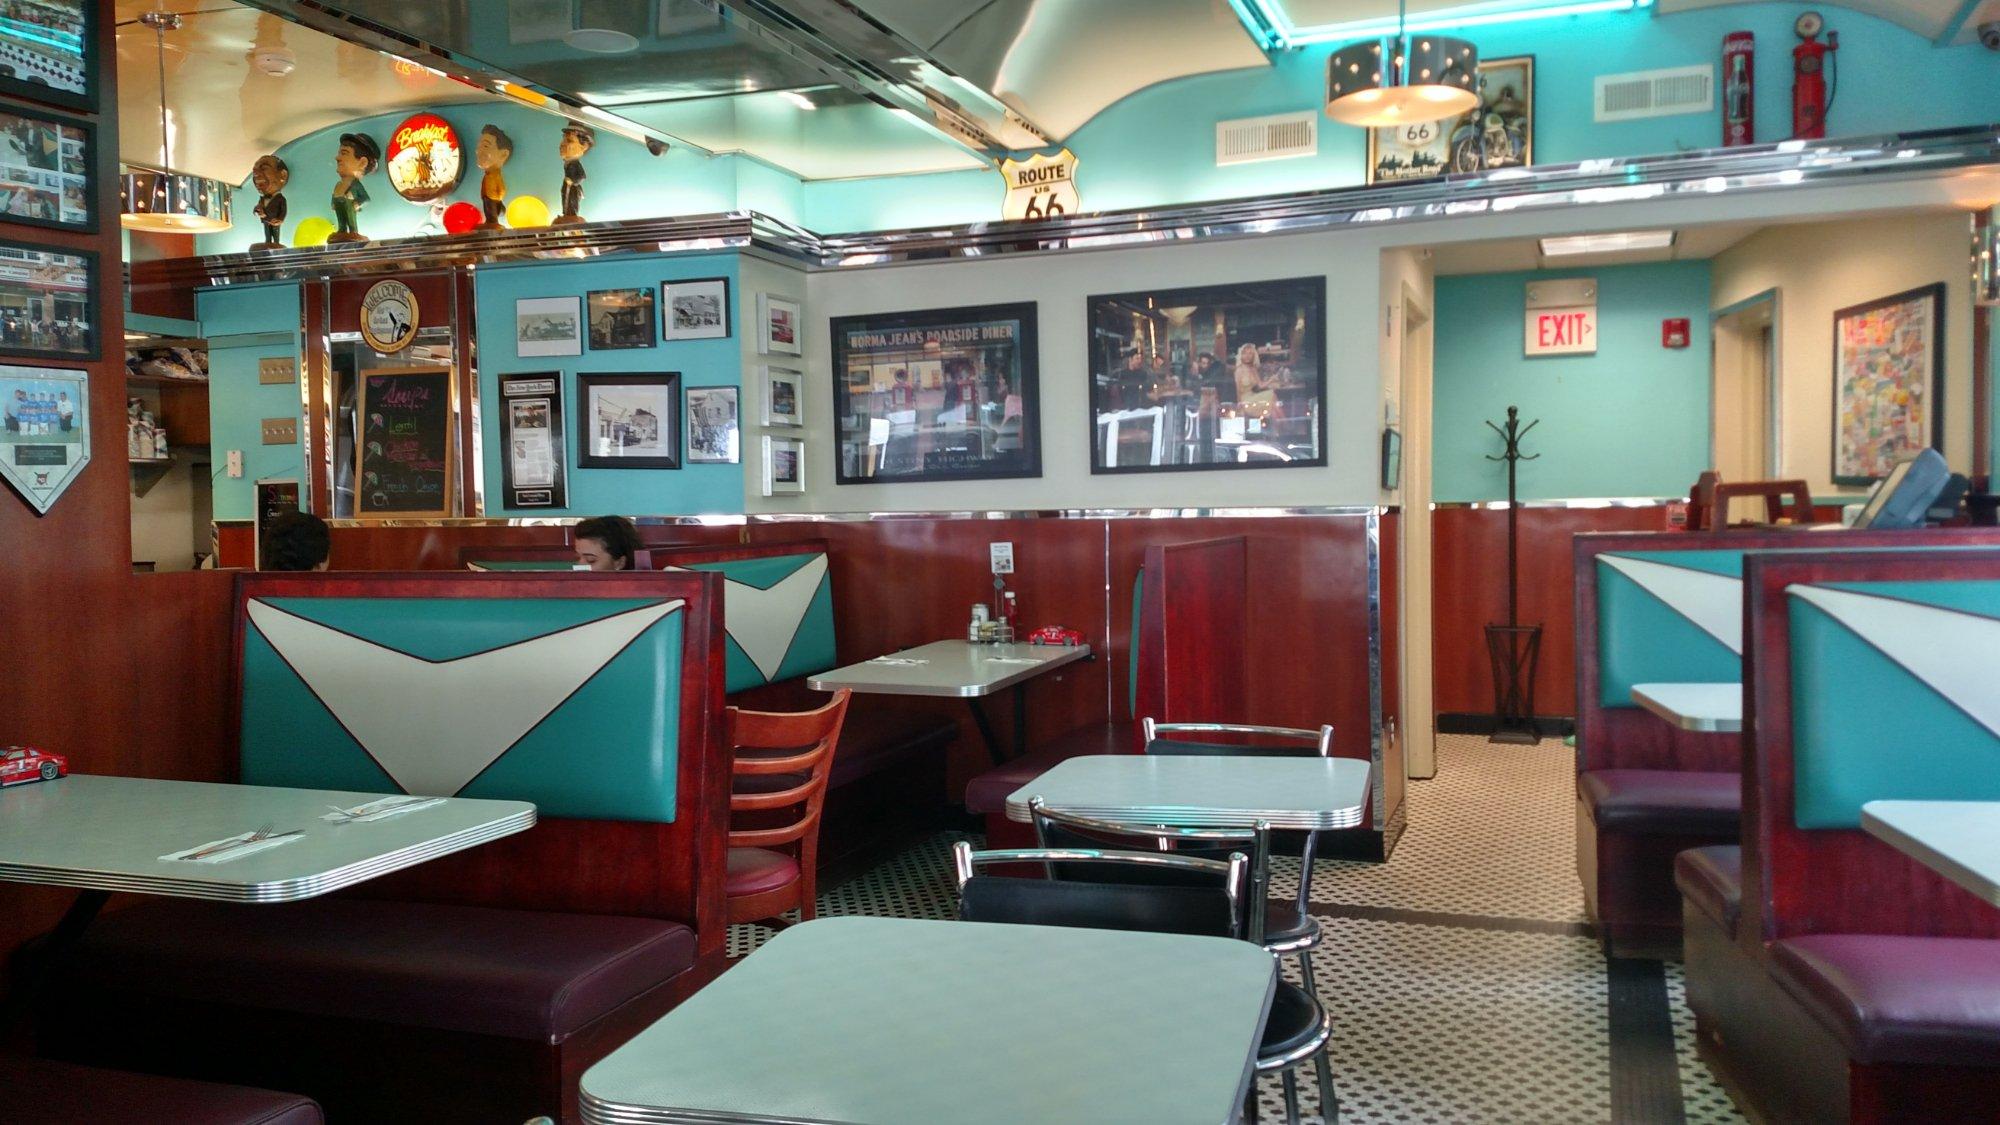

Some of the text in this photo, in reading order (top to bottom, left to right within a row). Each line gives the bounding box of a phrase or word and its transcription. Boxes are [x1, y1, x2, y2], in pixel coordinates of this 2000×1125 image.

[396, 123, 449, 149] Breakfast
[1407, 124, 1429, 140] 66
[1018, 164, 1065, 185] ROUTE
[1034, 185, 1051, 194] US
[1025, 192, 1065, 221] 66
[366, 284, 408, 312] WELCOME
[850, 325, 1013, 348] NORMA JEAN'S ROADSIDE DINER
[1538, 313, 1586, 347] EXIT
[17, 759, 26, 770] 1
